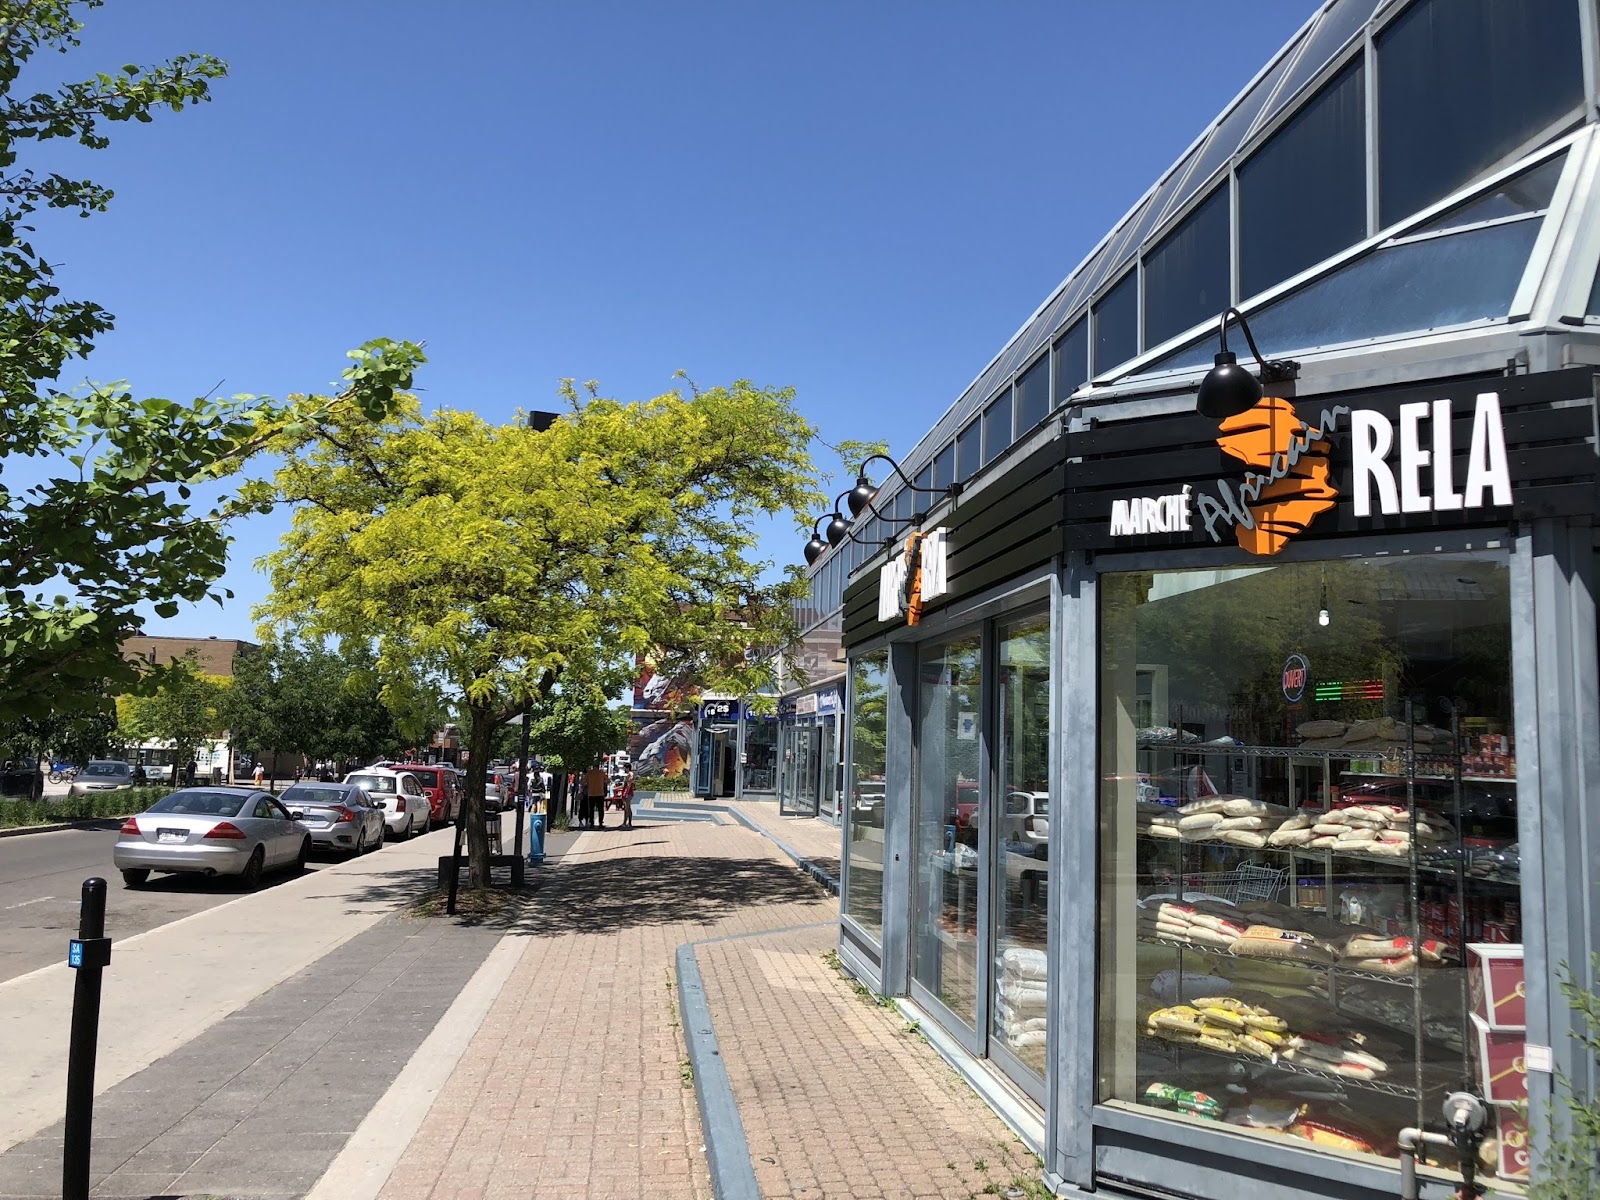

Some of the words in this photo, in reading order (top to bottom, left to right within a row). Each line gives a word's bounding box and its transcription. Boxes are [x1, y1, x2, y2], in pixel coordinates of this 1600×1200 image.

[1110, 485, 1193, 536] MARCHÉ
[1351, 392, 1514, 517] RELA
[1284, 667, 1305, 689] OUVERT
[72, 943, 80, 953] SA
